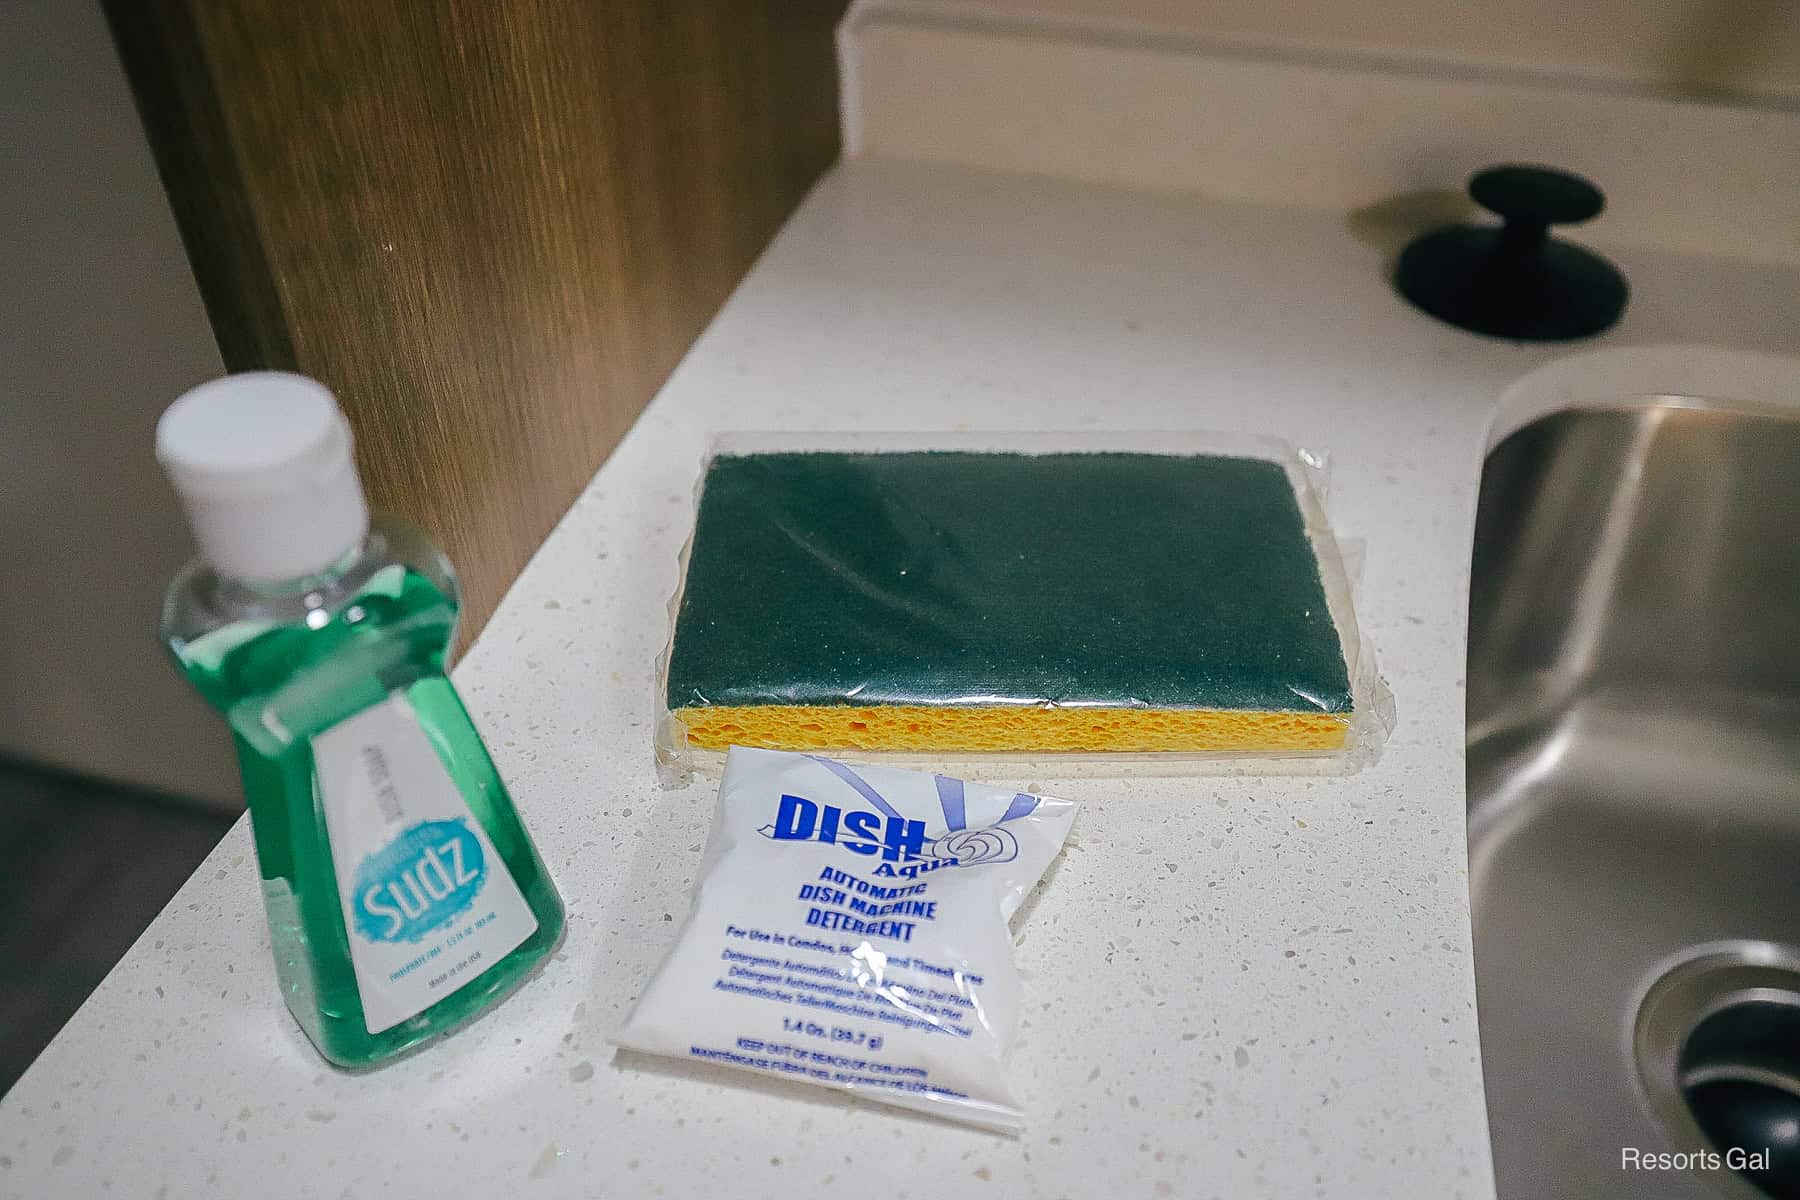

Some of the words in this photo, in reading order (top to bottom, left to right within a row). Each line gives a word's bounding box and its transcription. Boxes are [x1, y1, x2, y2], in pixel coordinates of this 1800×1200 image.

[773, 794, 926, 863] DISH
[820, 865, 927, 899] AUTOMATIC
[872, 857, 960, 880] Aqua
[364, 838, 479, 939] Sudz
[799, 884, 846, 906] DISH
[850, 896, 937, 921] MACHINE
[806, 907, 916, 943] DETERGENT
[726, 926, 747, 938] For
[750, 930, 771, 942] Use
[912, 959, 984, 985] Timeshres
